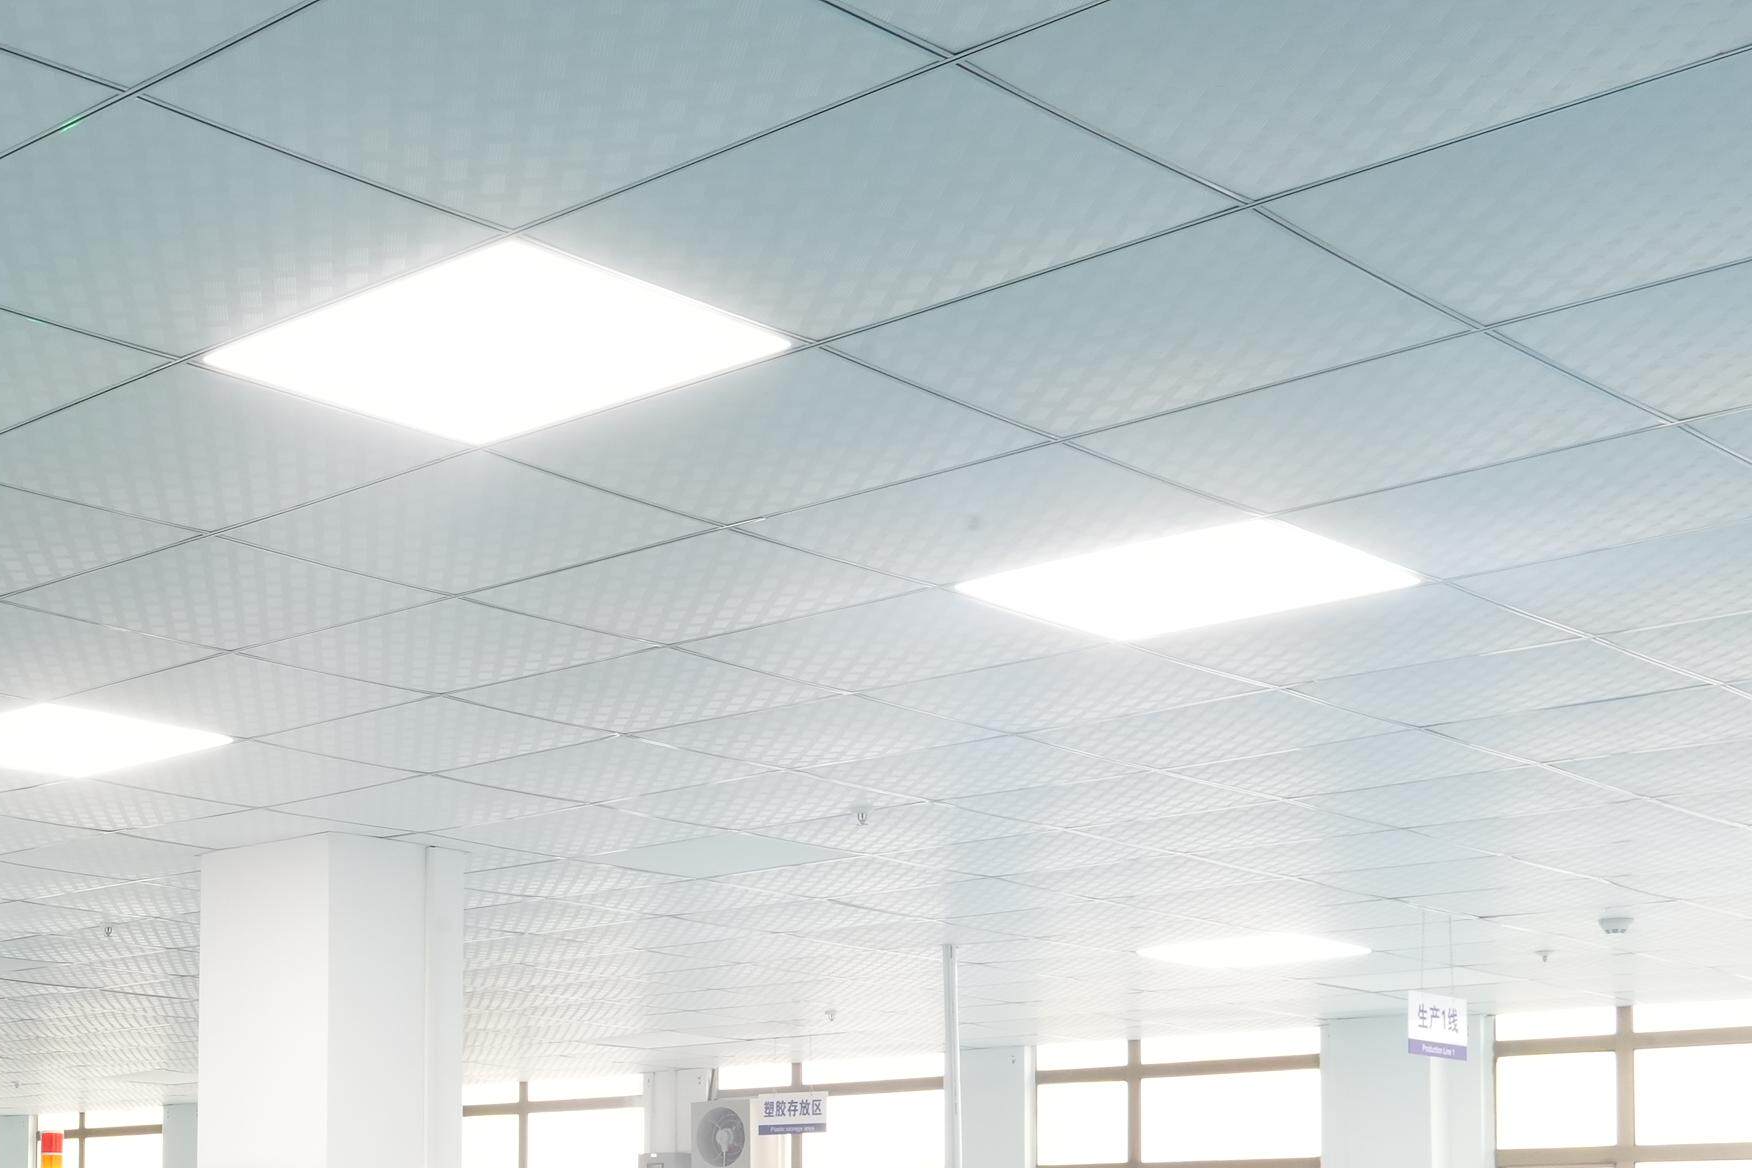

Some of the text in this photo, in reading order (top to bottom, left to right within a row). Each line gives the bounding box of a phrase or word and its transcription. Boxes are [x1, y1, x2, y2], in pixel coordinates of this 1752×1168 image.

[1418, 1003, 1458, 1033] 生产1线
[764, 1099, 823, 1117] 塑胶存放区
